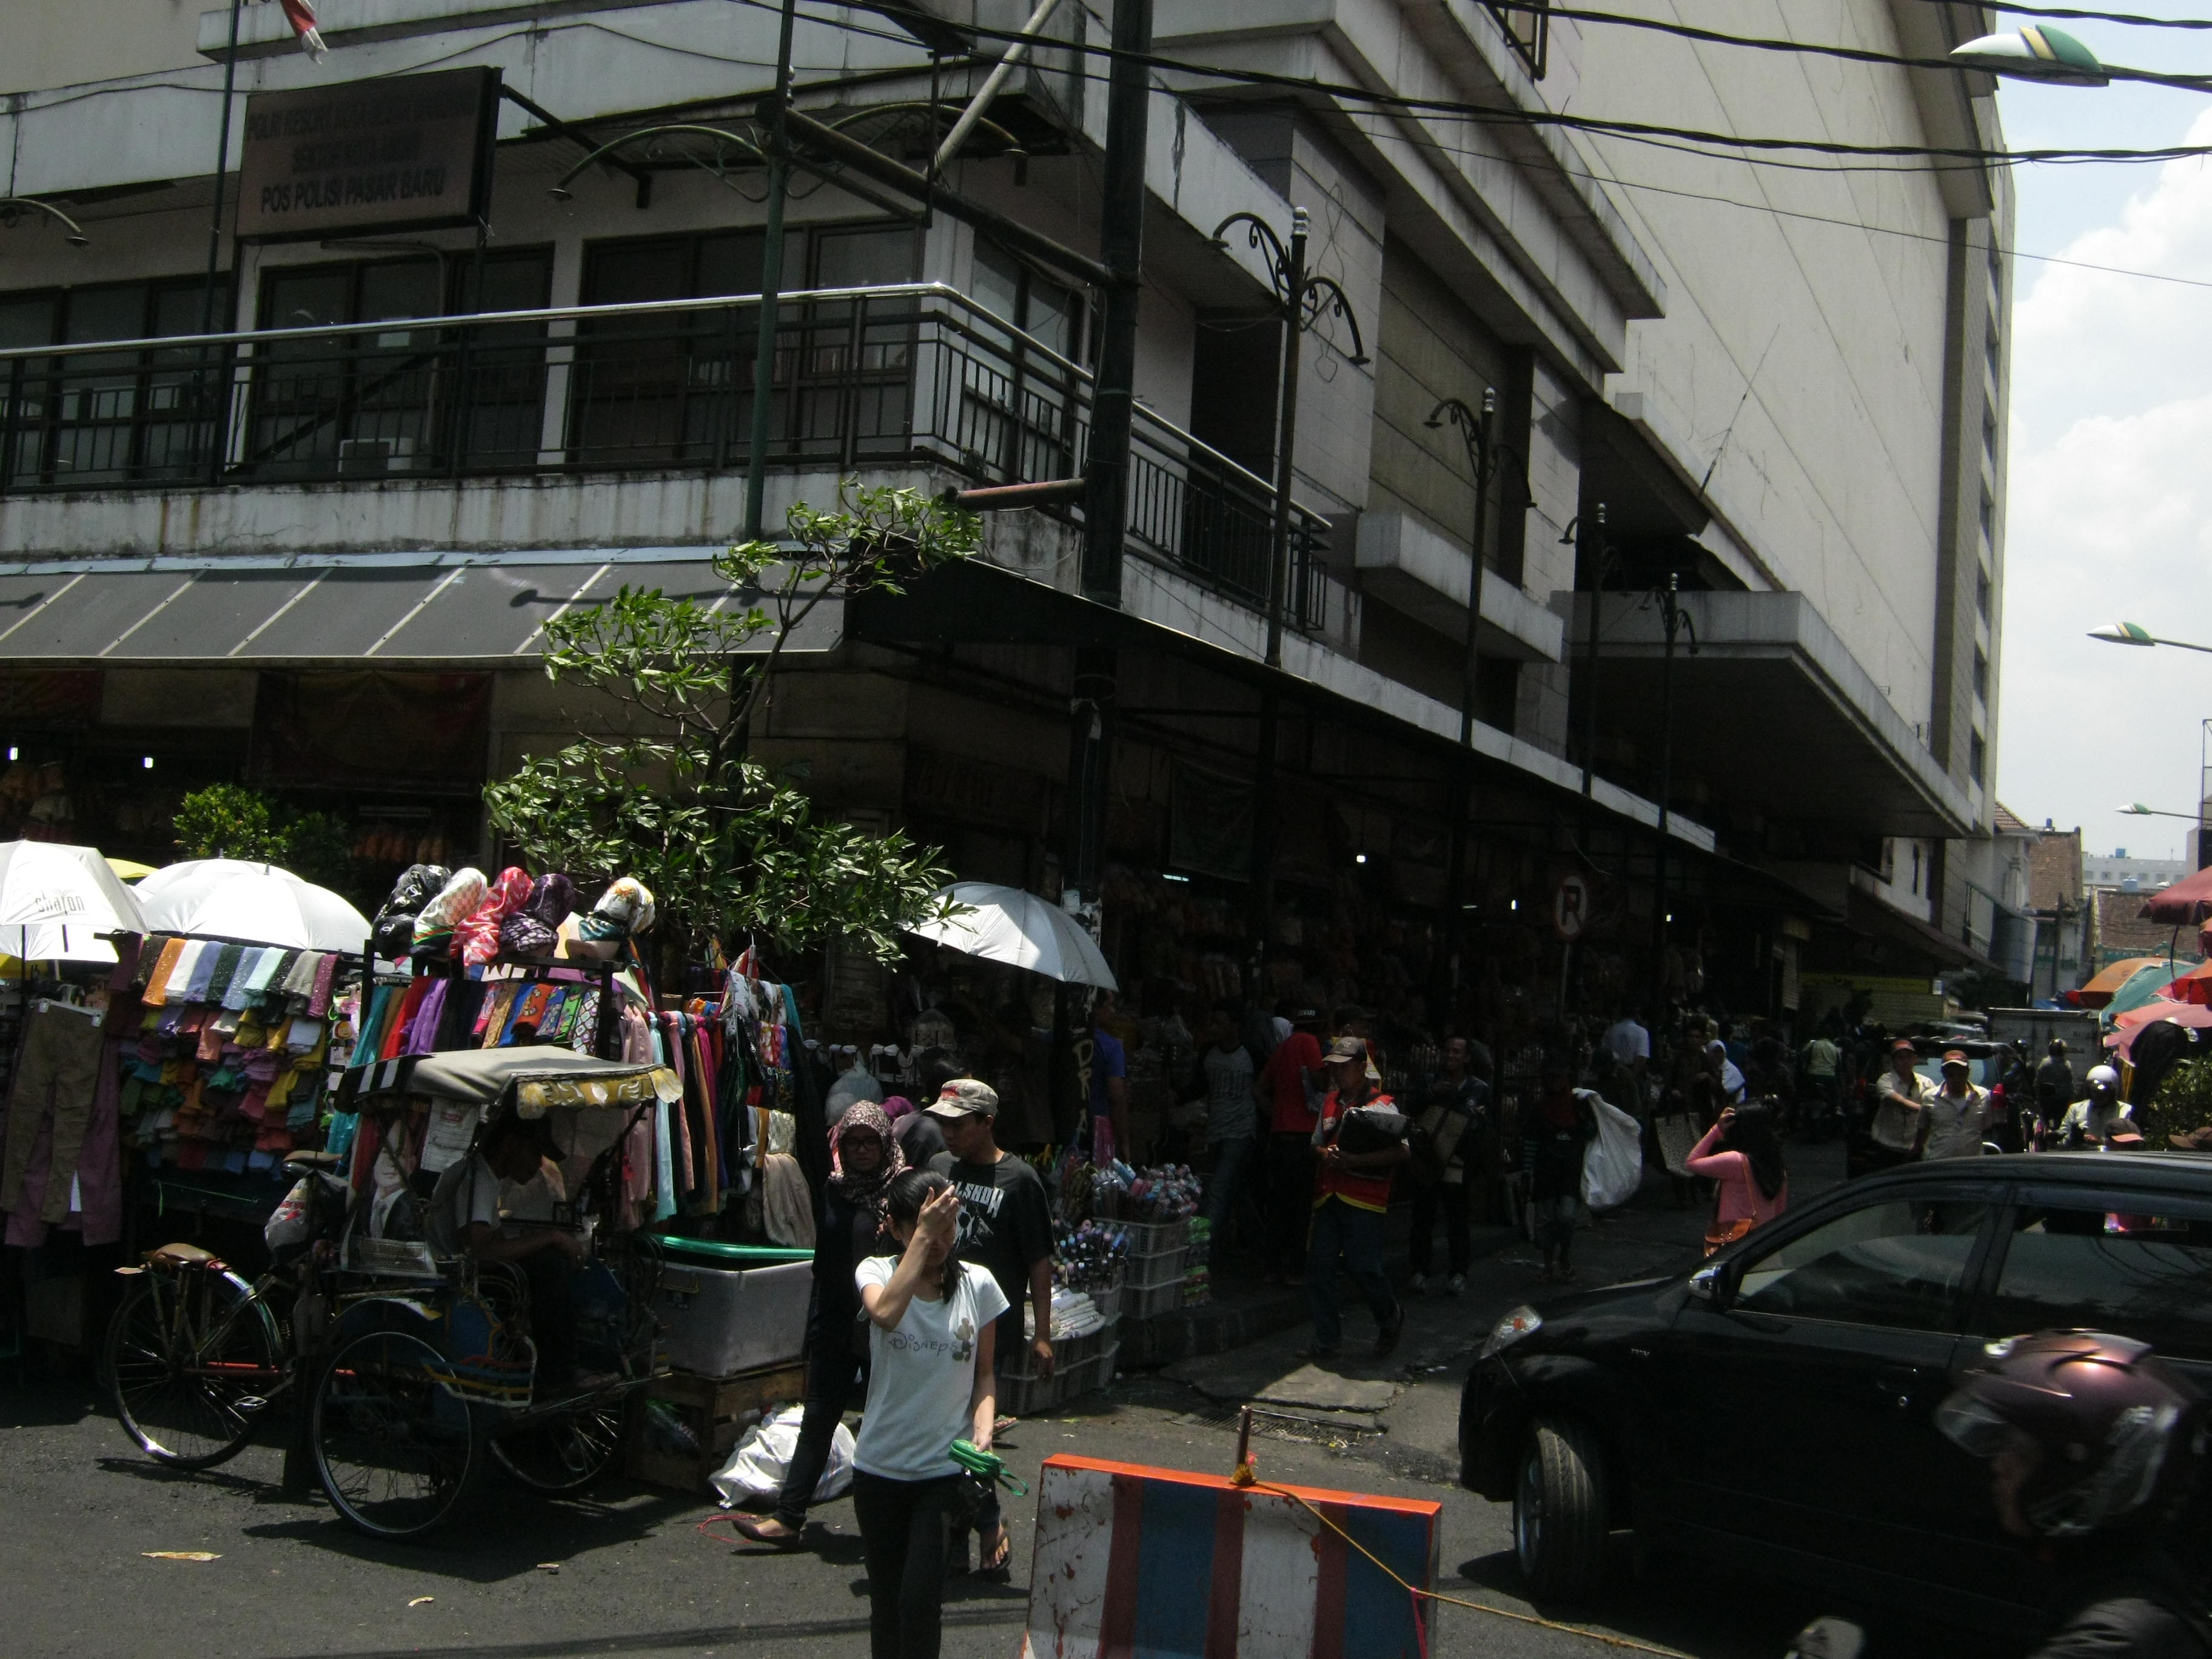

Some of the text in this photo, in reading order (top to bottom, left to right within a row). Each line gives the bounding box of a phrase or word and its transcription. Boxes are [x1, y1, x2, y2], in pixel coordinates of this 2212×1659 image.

[260, 167, 446, 214] POS POLISI PASAR BARU
